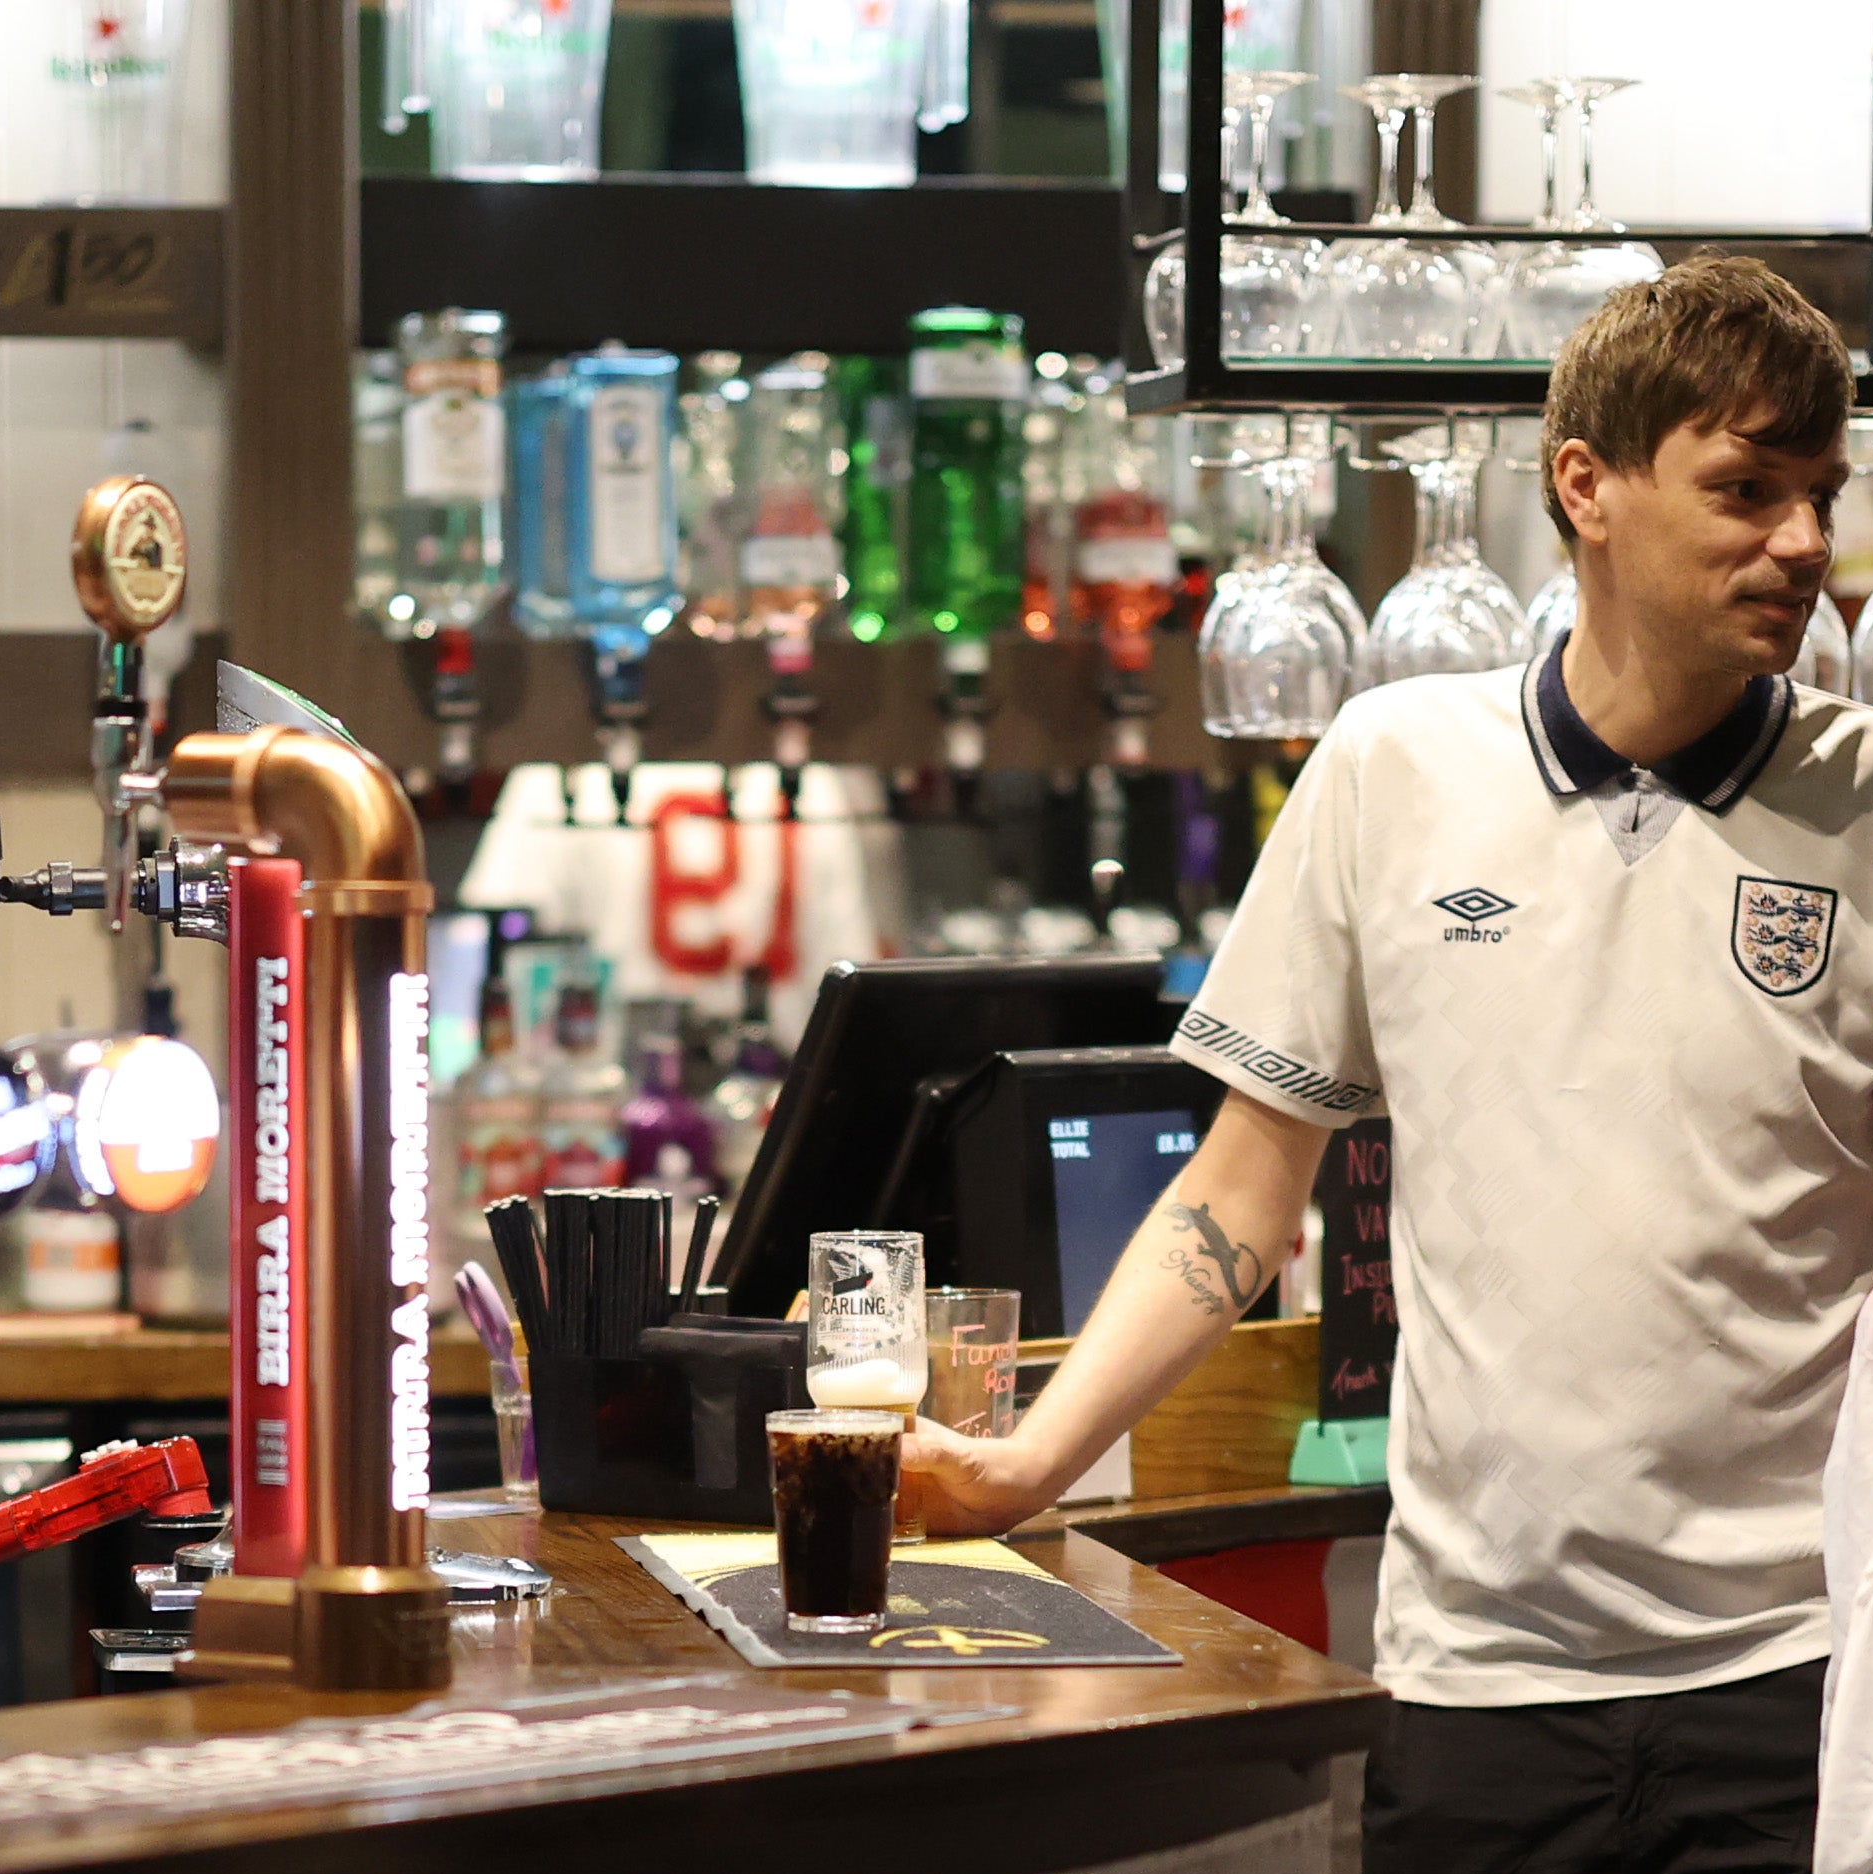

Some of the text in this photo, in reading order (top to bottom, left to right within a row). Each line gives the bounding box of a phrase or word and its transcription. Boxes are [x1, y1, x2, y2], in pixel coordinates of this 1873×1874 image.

[1444, 922, 1503, 943] umbro
[256, 956, 289, 1203] MORETTI
[256, 1215, 289, 1387] BIRRA
[822, 1296, 886, 1315] CARLING
